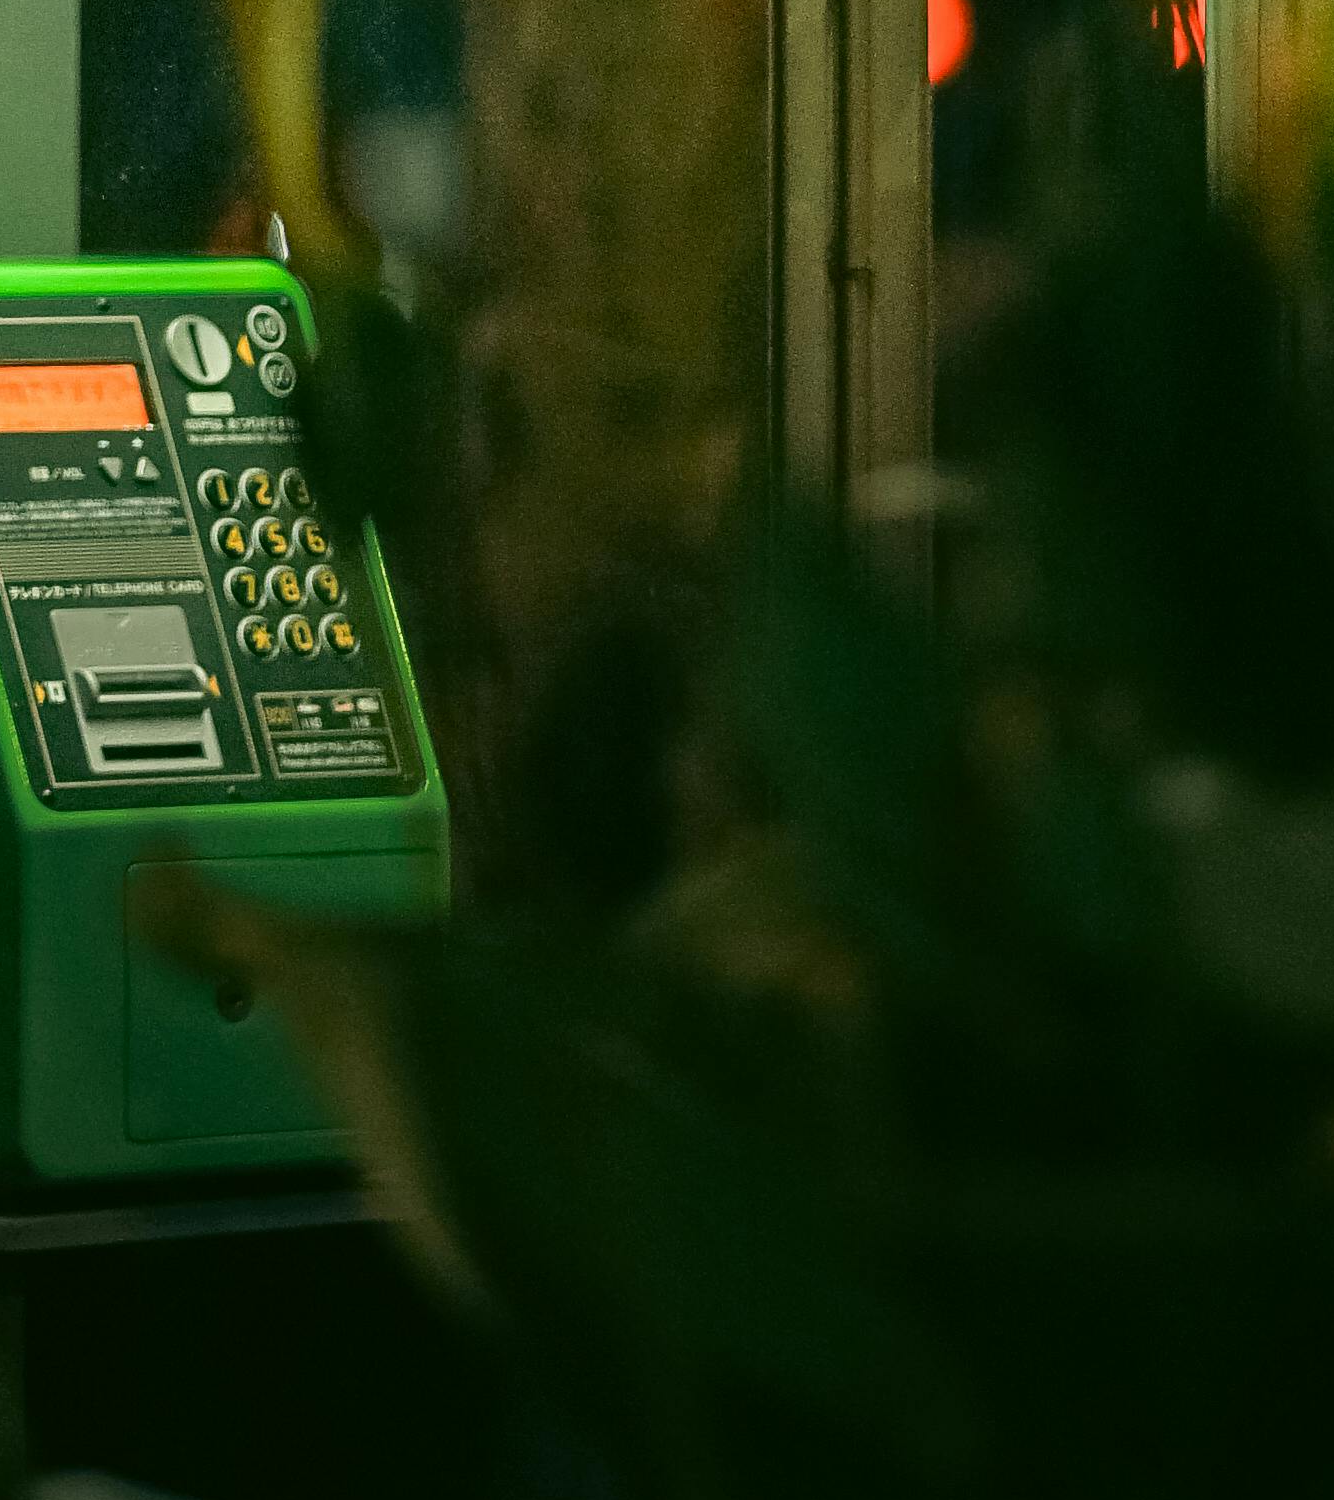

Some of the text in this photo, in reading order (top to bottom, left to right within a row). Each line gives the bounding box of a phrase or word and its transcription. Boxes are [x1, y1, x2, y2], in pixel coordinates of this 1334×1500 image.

[254, 474, 273, 506] 2
[226, 521, 326, 553] 4 5 6
[240, 570, 340, 602] 7 8 9
[292, 619, 314, 651] 0
